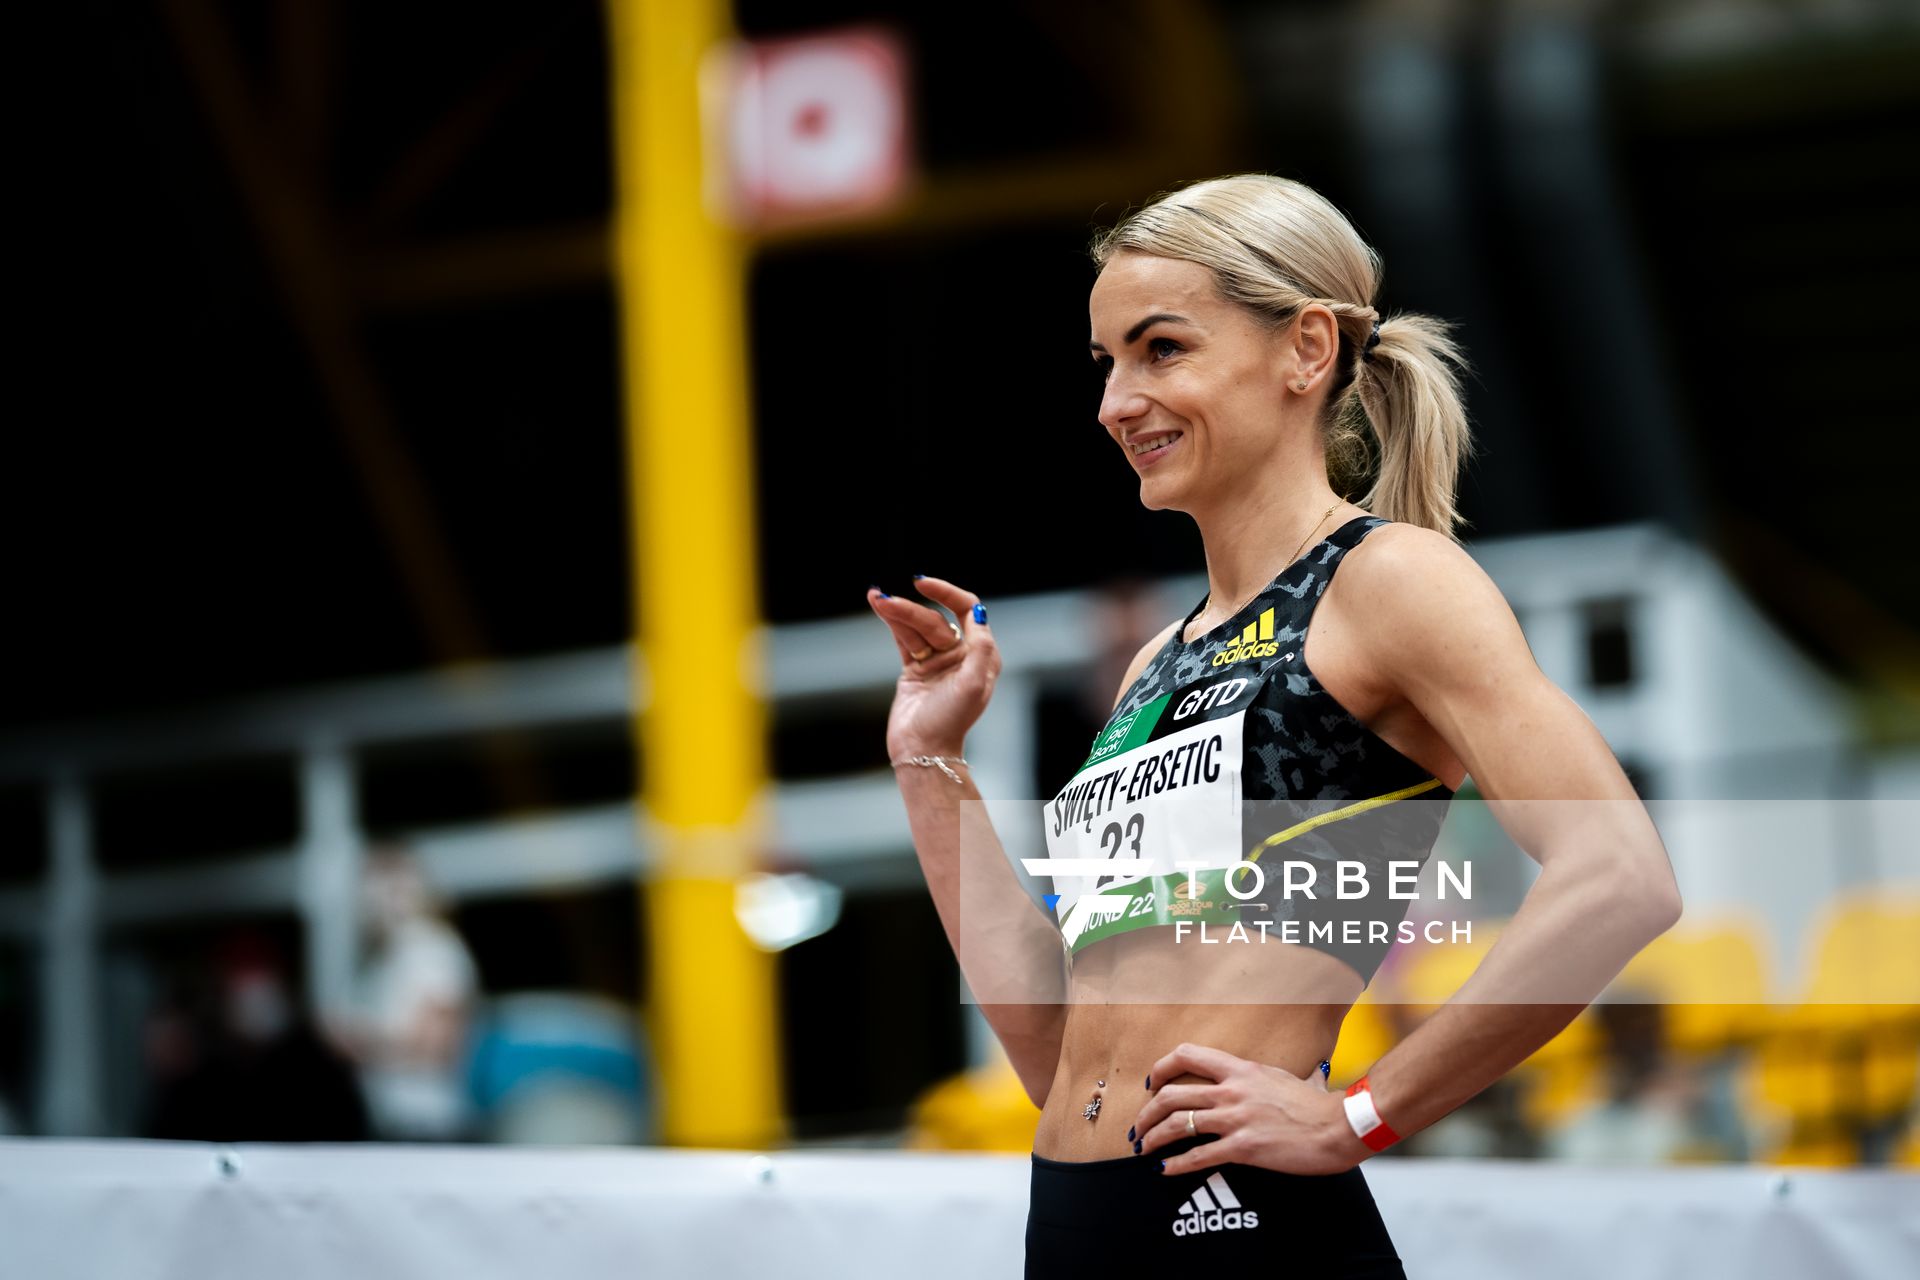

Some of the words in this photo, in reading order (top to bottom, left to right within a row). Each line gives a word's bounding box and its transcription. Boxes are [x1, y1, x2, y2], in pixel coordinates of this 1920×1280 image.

[1212, 640, 1279, 667] adidas
[1096, 813, 1145, 889] 23
[1128, 892, 1155, 918] 22
[1172, 1208, 1259, 1237] adidas
